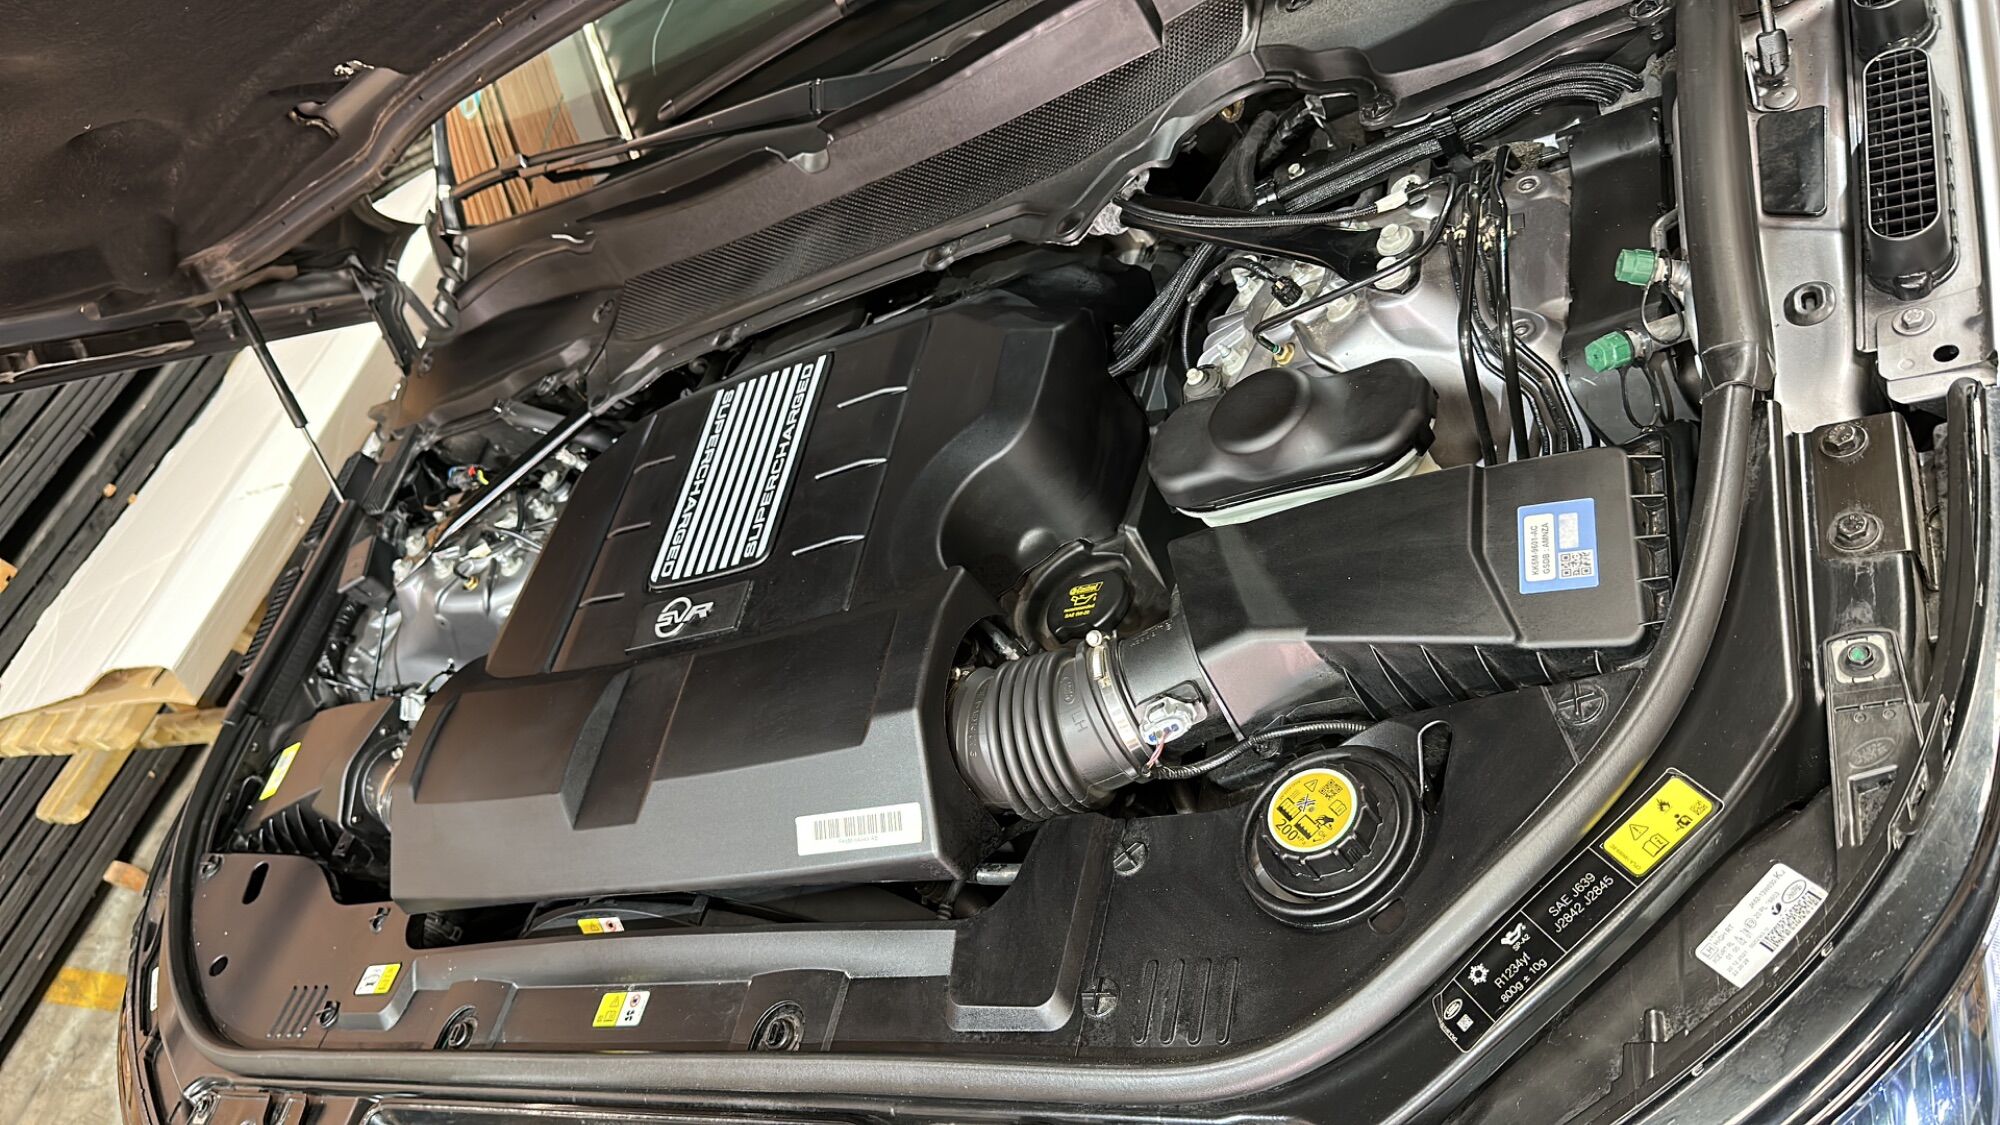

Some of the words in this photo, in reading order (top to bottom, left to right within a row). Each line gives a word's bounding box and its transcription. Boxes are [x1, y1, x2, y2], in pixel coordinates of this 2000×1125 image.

[660, 388, 736, 577] SUPERCHARGED
[745, 363, 815, 558] SUPERCHARGED
[655, 597, 714, 638] SVR
[1070, 711, 1089, 734] LH
[1275, 819, 1299, 841] 200
[1548, 894, 1573, 917] SAE
[1572, 872, 1596, 898] J639
[1555, 902, 1585, 934] J2842
[1584, 875, 1614, 906] J2845
[1494, 952, 1531, 989] R1234yf
[1500, 981, 1524, 1003] 800g
[1529, 958, 1548, 976] 10g
